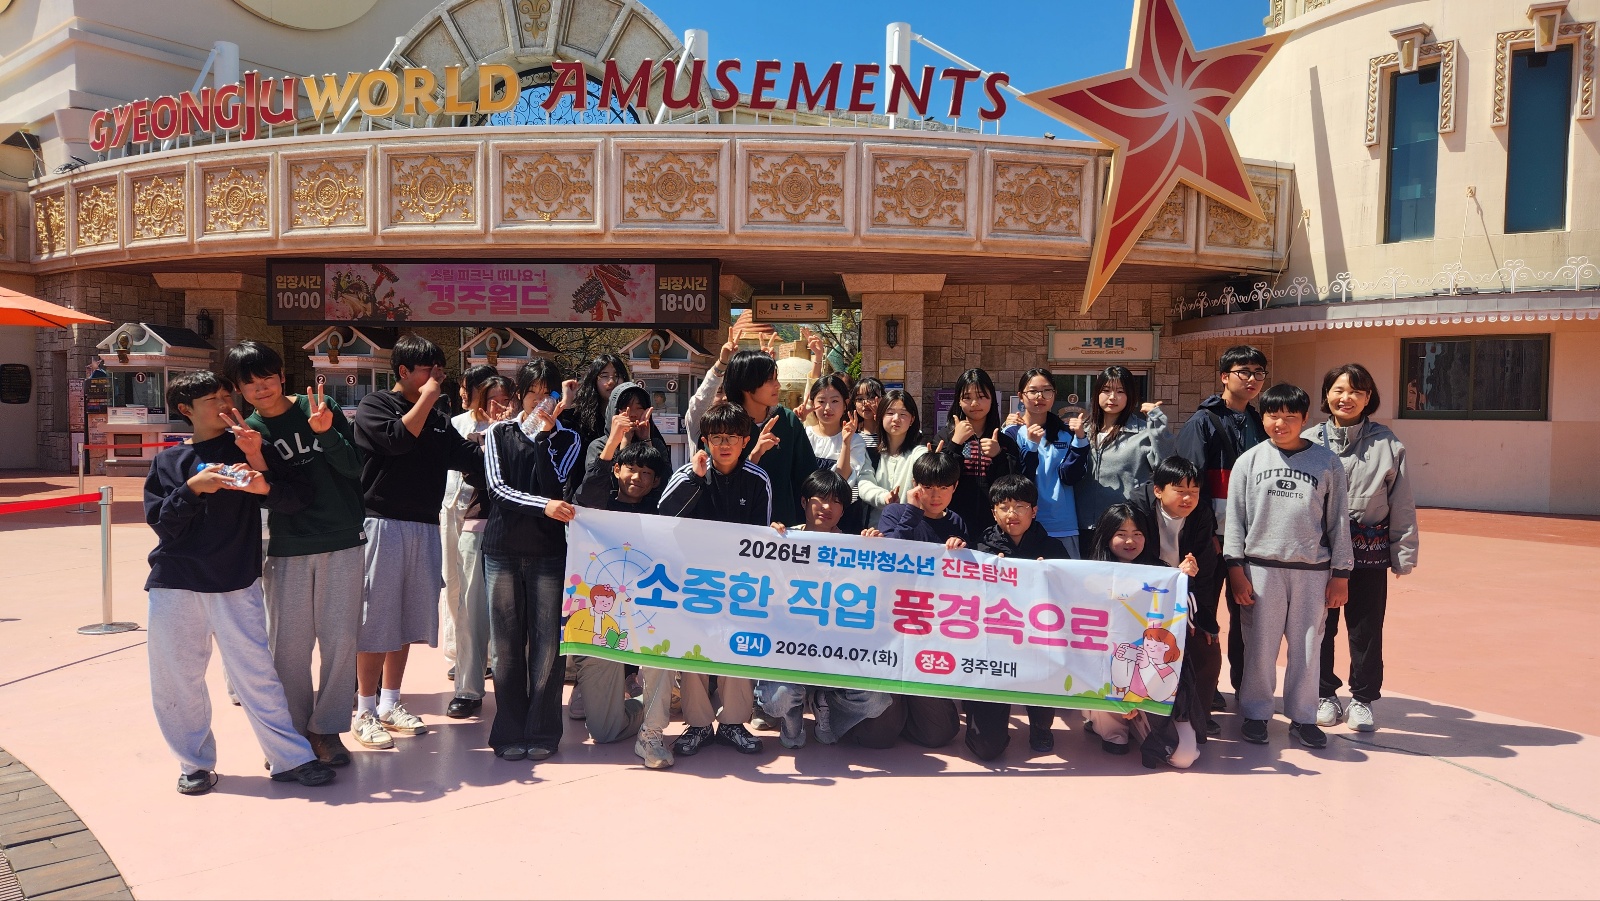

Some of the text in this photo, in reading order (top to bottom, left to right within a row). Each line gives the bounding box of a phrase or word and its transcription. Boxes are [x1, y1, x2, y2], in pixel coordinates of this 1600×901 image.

[88, 59, 1010, 152] GYEONGJU WORLD AMUSEMENTS
[275, 275, 321, 289] 입장시간
[430, 269, 454, 281] 스릴
[457, 269, 494, 281] 피크닉
[658, 276, 708, 291] 퇴장시간
[276, 291, 321, 309] 10:00
[427, 284, 550, 315] 경주월드
[659, 293, 706, 312] 18:00
[770, 303, 814, 311] 나오는곳
[1081, 337, 1125, 348] 고객센터
[1256, 468, 1319, 490] OUTDOOR
[1281, 480, 1292, 489] 73
[1267, 489, 1304, 499] PRODUCTS
[738, 538, 1018, 587] 2026년 학교밖청소년 진로탐색
[634, 563, 1109, 652] 소중한 직업 풍경속으로
[735, 634, 898, 667] 일시 2026.04.07.(화)
[920, 654, 1017, 678] 장소 경주일대
